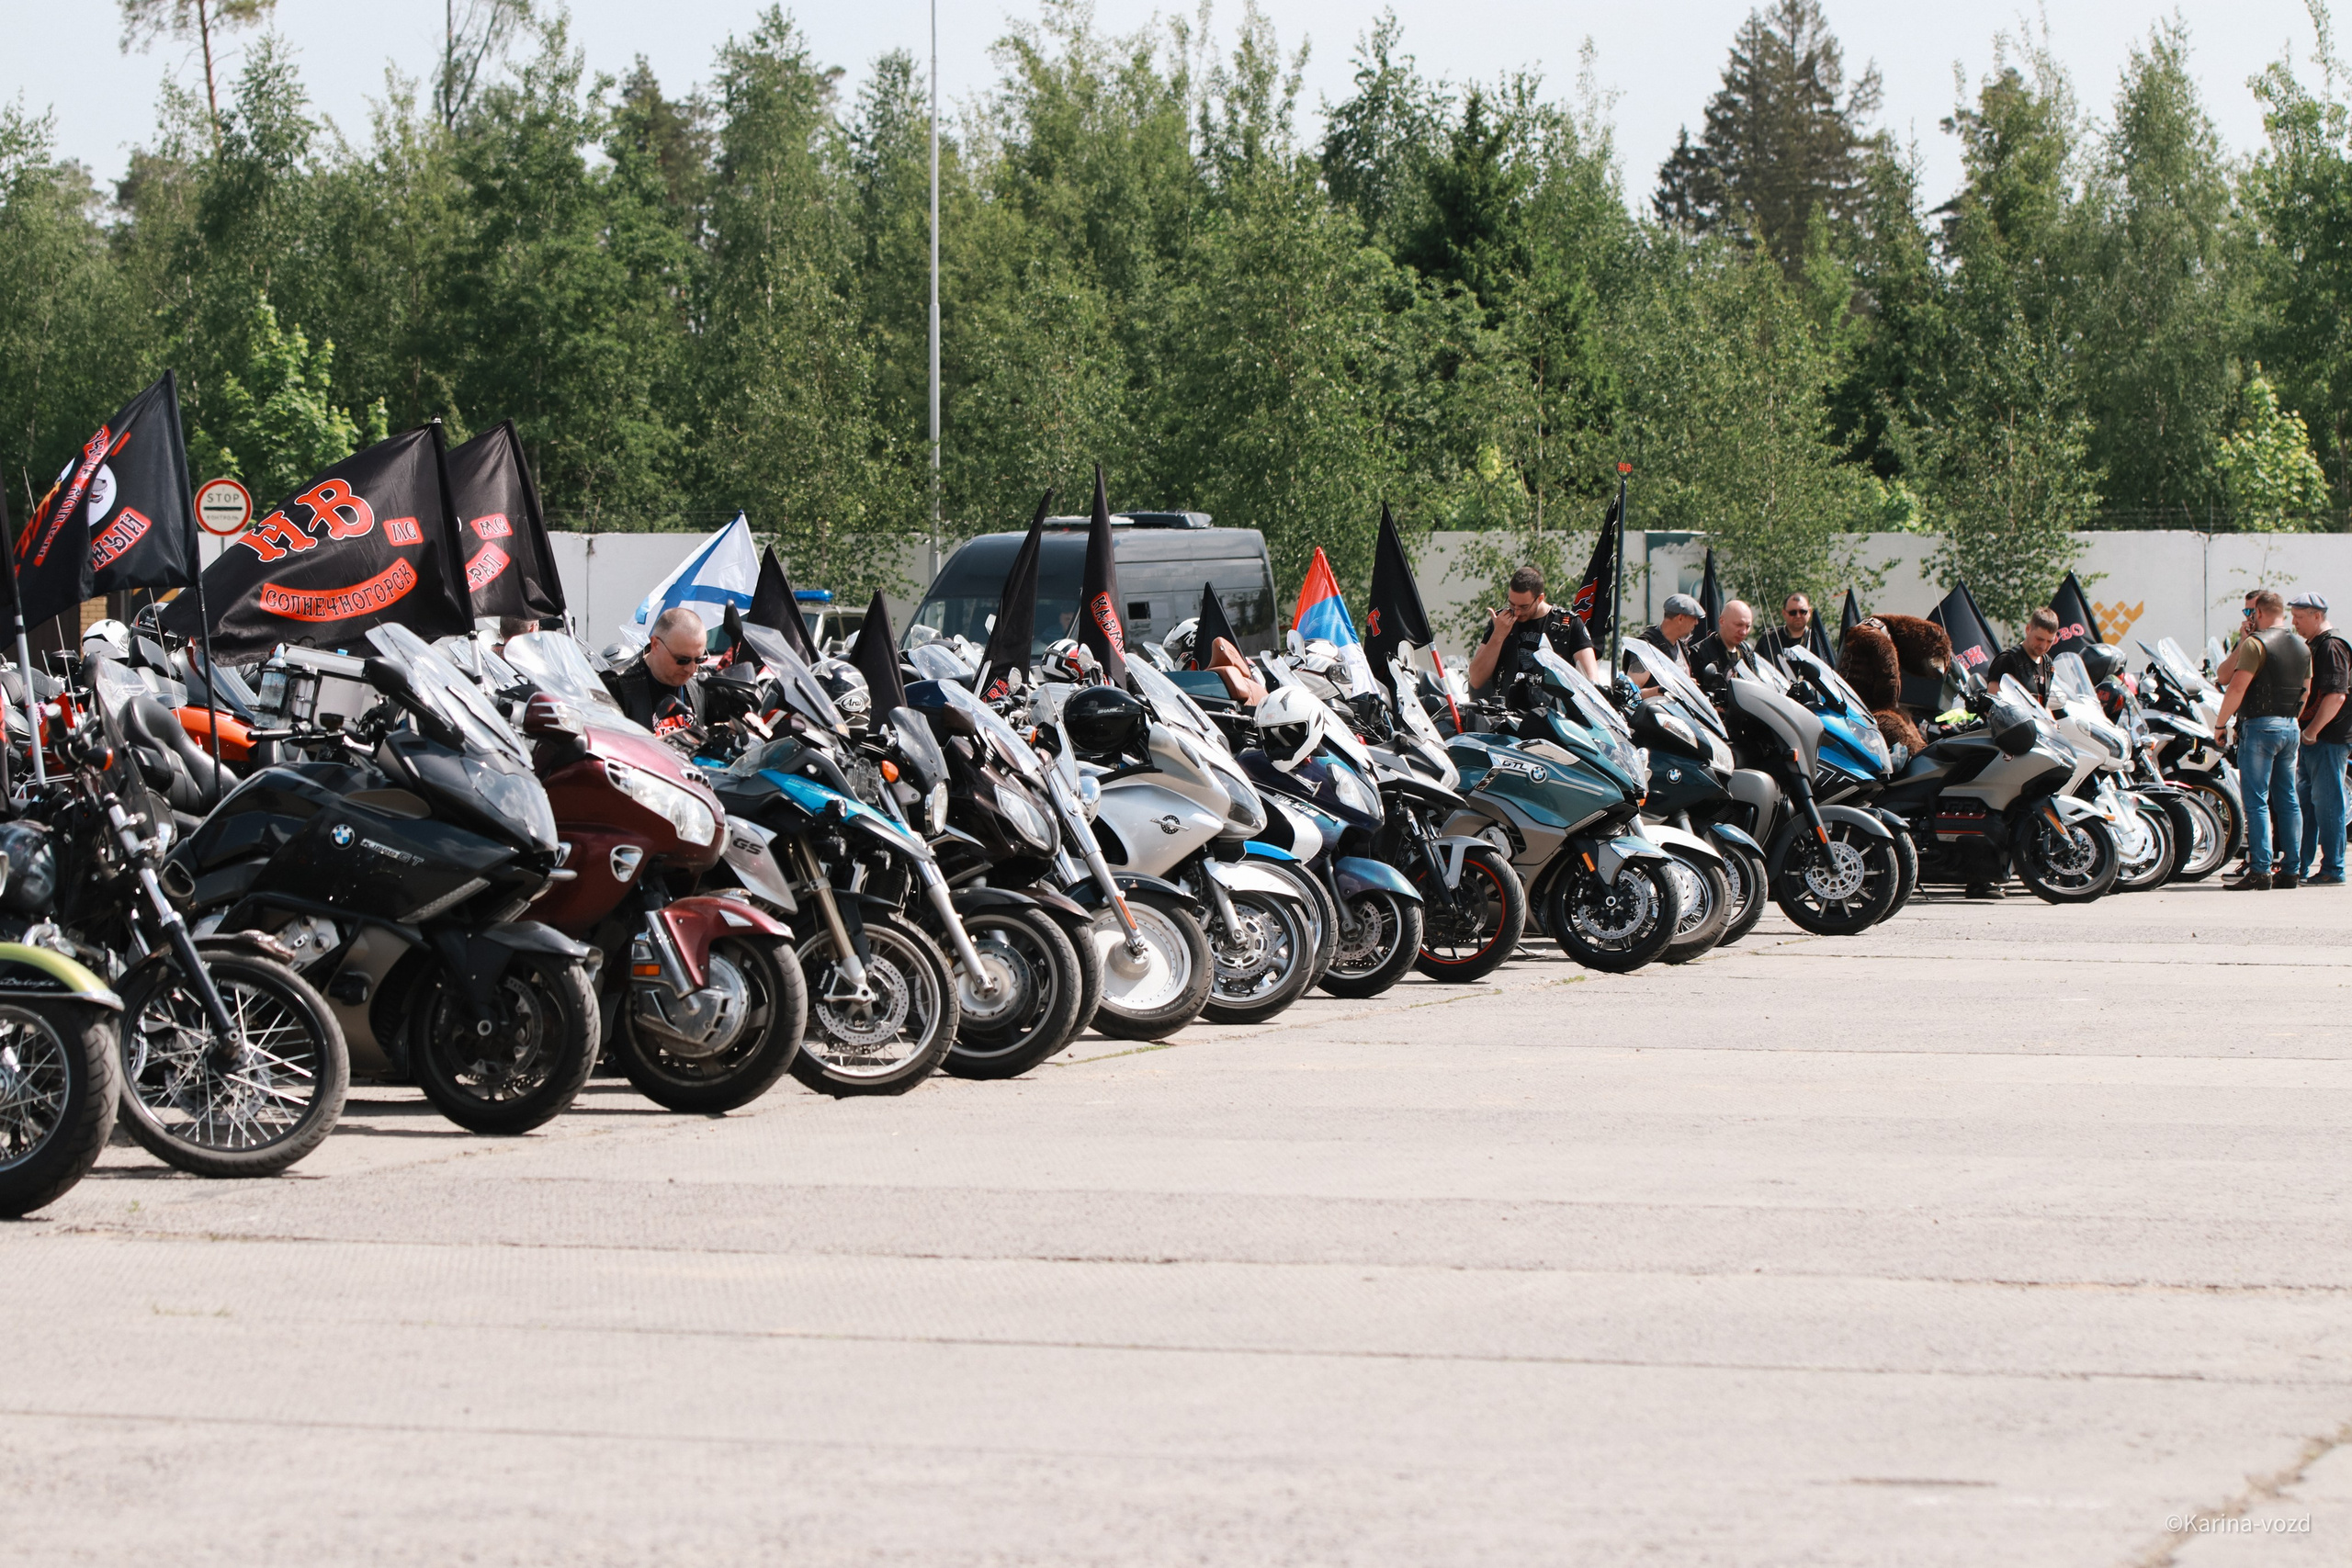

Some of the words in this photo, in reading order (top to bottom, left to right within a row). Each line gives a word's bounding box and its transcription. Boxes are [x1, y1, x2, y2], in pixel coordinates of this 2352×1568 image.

[207, 492, 240, 503] STOP
[467, 553, 503, 590] РАЛ
[265, 563, 414, 617] СОЛНЕЧНОГОРСК
[1502, 760, 1527, 771] GTL
[733, 837, 764, 855] GS
